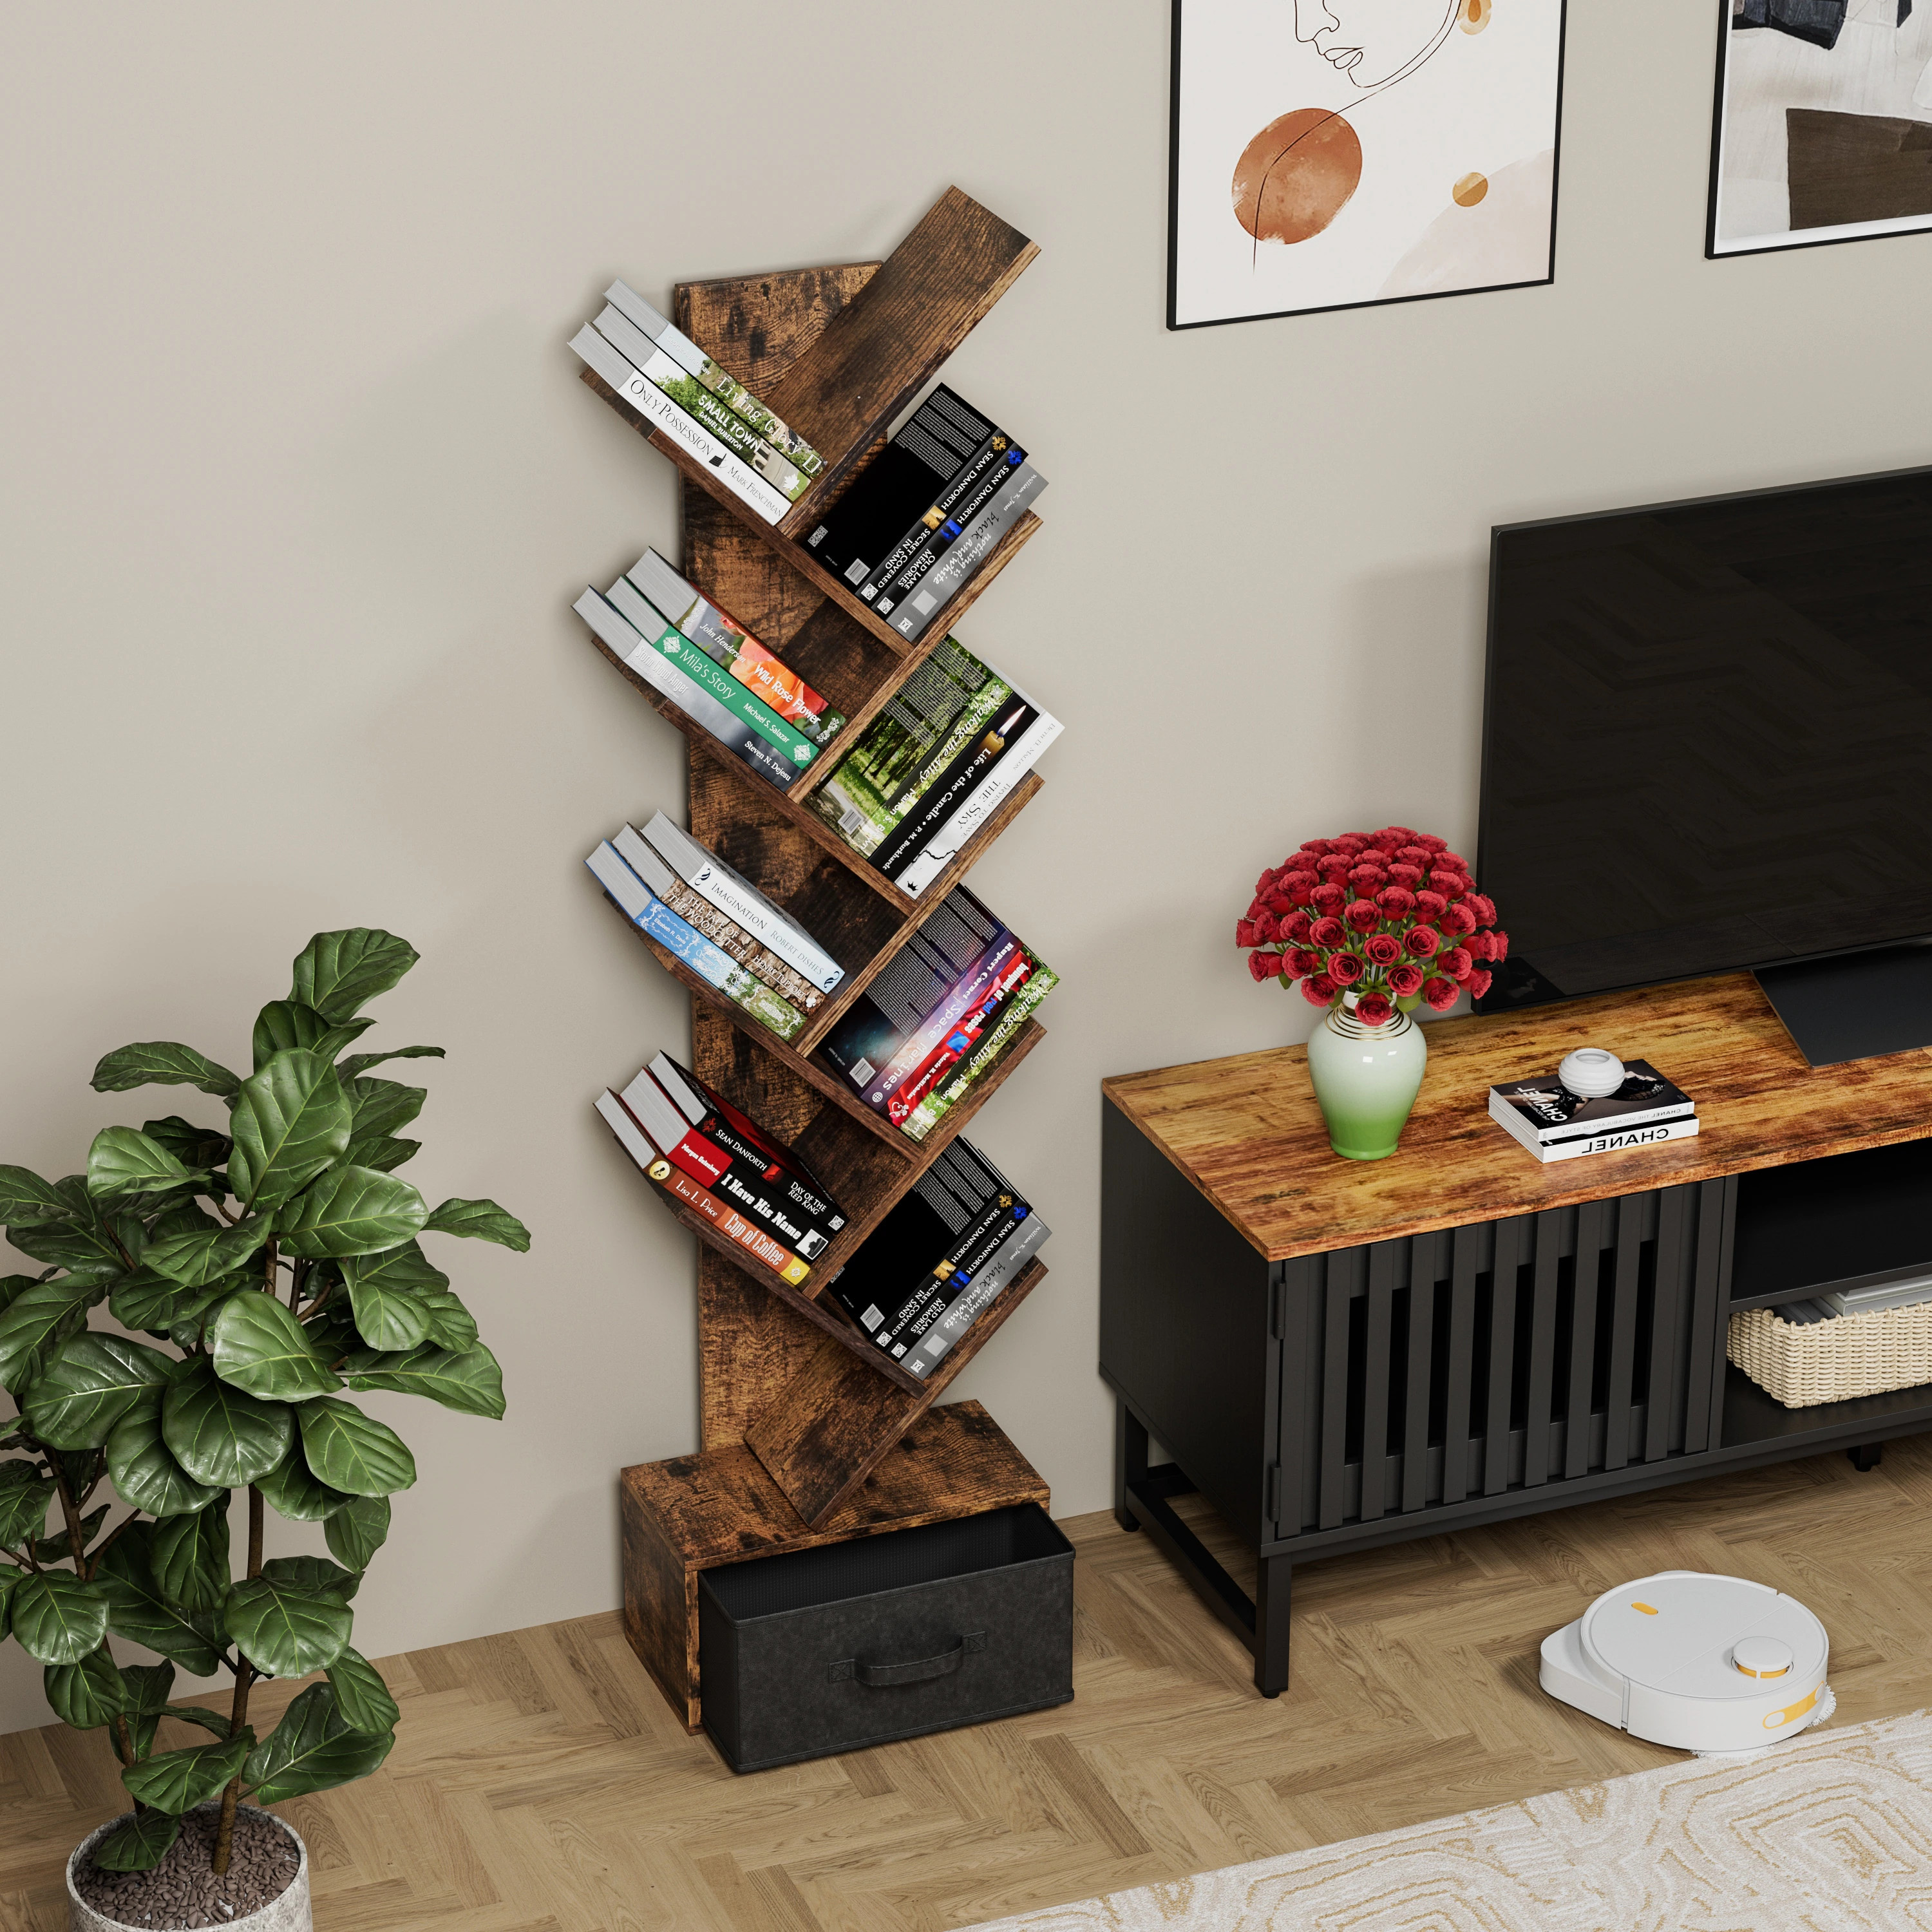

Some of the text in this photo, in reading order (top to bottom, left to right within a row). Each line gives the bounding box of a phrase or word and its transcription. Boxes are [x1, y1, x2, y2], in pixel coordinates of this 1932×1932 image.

[630, 379, 714, 456] ONLY POSSESSION
[698, 394, 761, 453] SMALL TOWN
[699, 412, 744, 450] DANIEL RUBERTON
[716, 377, 802, 455] Living Glory
[975, 451, 994, 471] SEAN
[728, 466, 783, 517] MARK FRENCHMAN
[941, 470, 978, 510] DANFORTH
[956, 465, 1009, 524] SEAN DANFORTH
[878, 528, 931, 588] SECRET COVERED
[885, 538, 913, 570] IN SAND
[933, 511, 999, 584] black and white
[953, 533, 992, 578] nothing is
[898, 549, 933, 587] MEMORIES
[905, 556, 936, 590] OLD LAKE
[699, 623, 746, 663] John Henderson
[635, 645, 655, 667] Storm
[652, 659, 673, 681] Cloud
[668, 674, 690, 694] Anger
[679, 649, 710, 677] Mila's
[707, 672, 736, 699] Story
[753, 664, 822, 724] Wild Rose Flower
[743, 703, 790, 743] Michael S. Salazar
[920, 697, 999, 783] Walking the Alley
[744, 741, 791, 781] Steven N. Dejesu
[964, 766, 974, 779] of
[974, 748, 991, 766] Life
[951, 776, 966, 791] the
[925, 791, 952, 821] Candle
[958, 780, 1001, 829] THE SKY
[961, 783, 1013, 838] TRYING TO SAVE
[882, 840, 911, 870] Burkhardt
[908, 831, 918, 840] M.
[654, 918, 670, 933] Elizabeth
[675, 934, 687, 945] Davis
[668, 894, 746, 959] THE WOODCUTTER
[687, 895, 739, 939] THE FATE OF
[711, 884, 824, 975] IMAGINATION ROBERT DISHES
[753, 954, 806, 998] HENRY TUPPORT
[987, 942, 1014, 972] Rupert
[962, 971, 988, 999] Cornet
[963, 962, 1030, 1034] bouquet of red roses
[927, 1005, 961, 1039] Space
[969, 987, 1046, 1069] Walking the Alley
[882, 1043, 927, 1090] Marines
[934, 1052, 951, 1068] Valerie
[907, 1074, 932, 1100] McNicholas
[681, 1143, 721, 1176] Morgan Gutenberg
[715, 1130, 768, 1171] SEAN DANFORTH
[676, 1180, 718, 1217] Lisa L. Price
[721, 1173, 802, 1240] I Have His Name
[788, 1189, 820, 1215] RED KING
[790, 1181, 827, 1212] DAY OF THE
[983, 1208, 1001, 1227] SEAN
[724, 1213, 784, 1265] Cup of Coffee
[951, 1226, 985, 1263] DANFORTH
[966, 1220, 1016, 1274] SEAN DANFORTH
[891, 1280, 942, 1336] SECRET COVERED
[898, 1289, 925, 1318] IN SAND
[943, 1261, 1005, 1329] black and white
[962, 1280, 999, 1322] nothing is
[910, 1297, 943, 1334] MEMORIES
[916, 1303, 946, 1336] OLD LAKE
